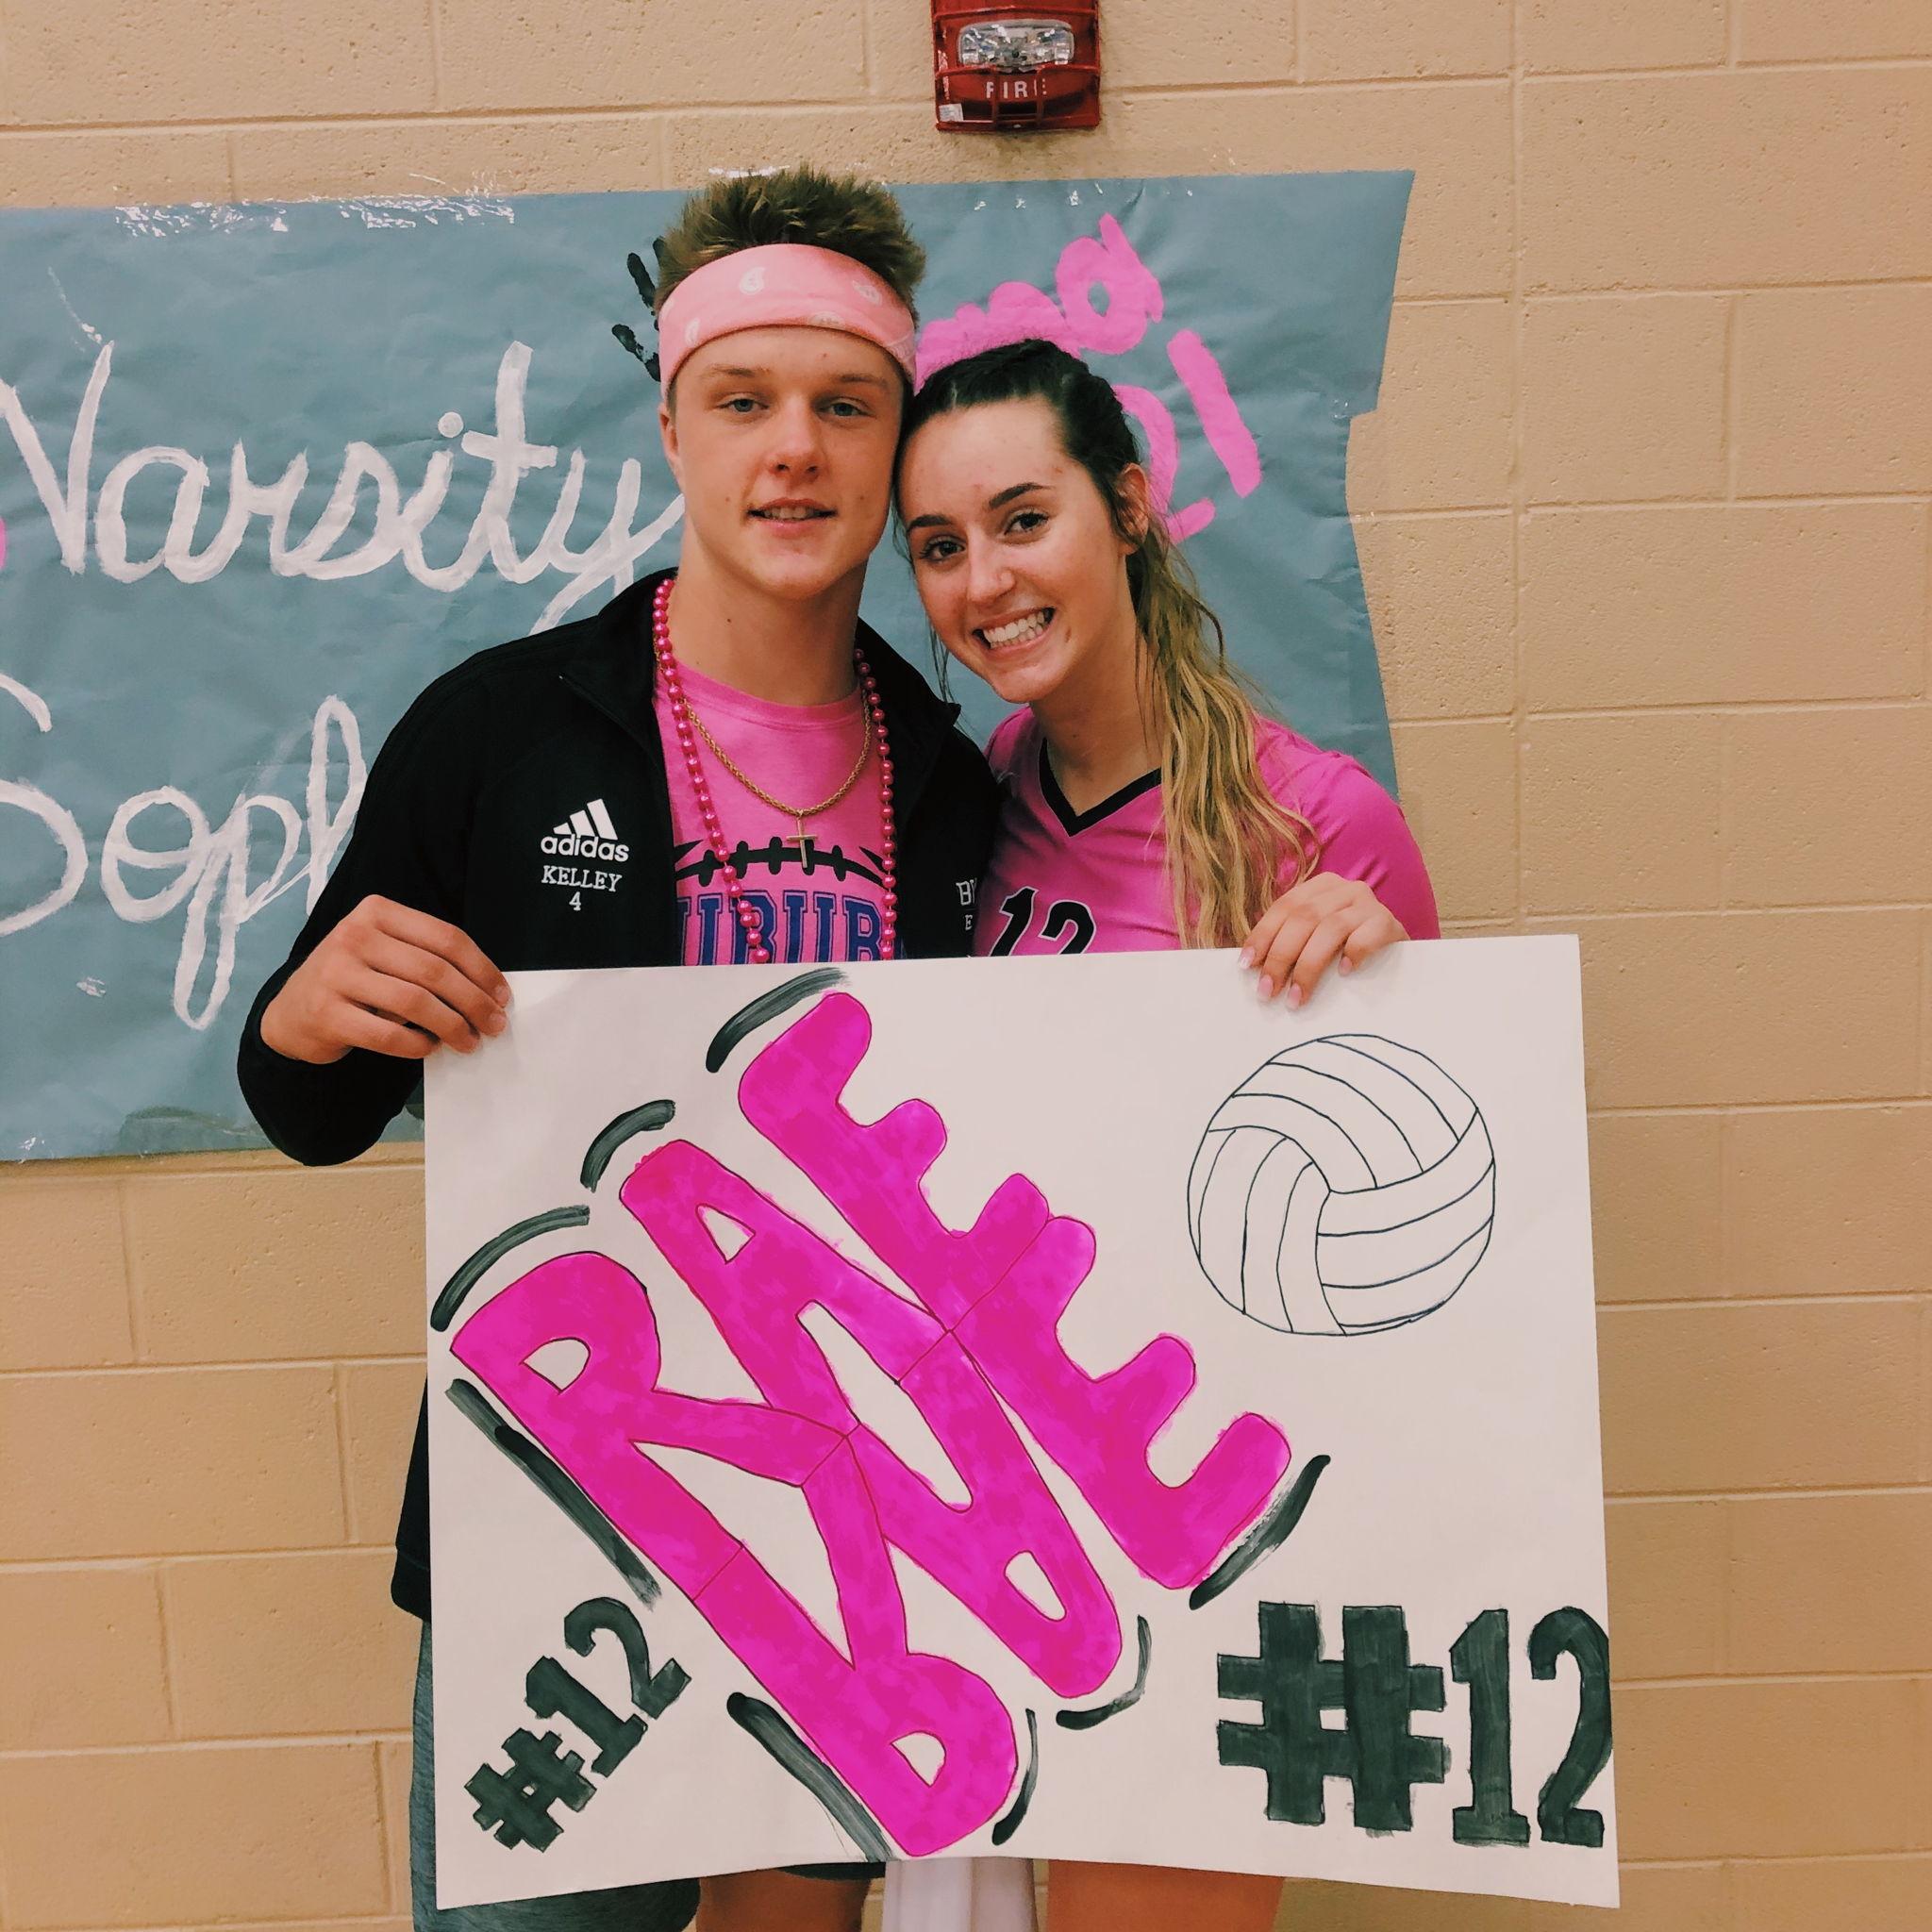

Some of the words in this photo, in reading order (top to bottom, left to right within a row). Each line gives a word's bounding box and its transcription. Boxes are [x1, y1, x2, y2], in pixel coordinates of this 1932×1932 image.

[0, 341, 684, 636] Varsity
[540, 833, 630, 862] adidas
[541, 865, 623, 892] KELLEY
[569, 891, 582, 911] 4
[989, 886, 1097, 957] 12
[463, 1596, 691, 1853] #12
[1216, 1601, 1612, 1849] #12
